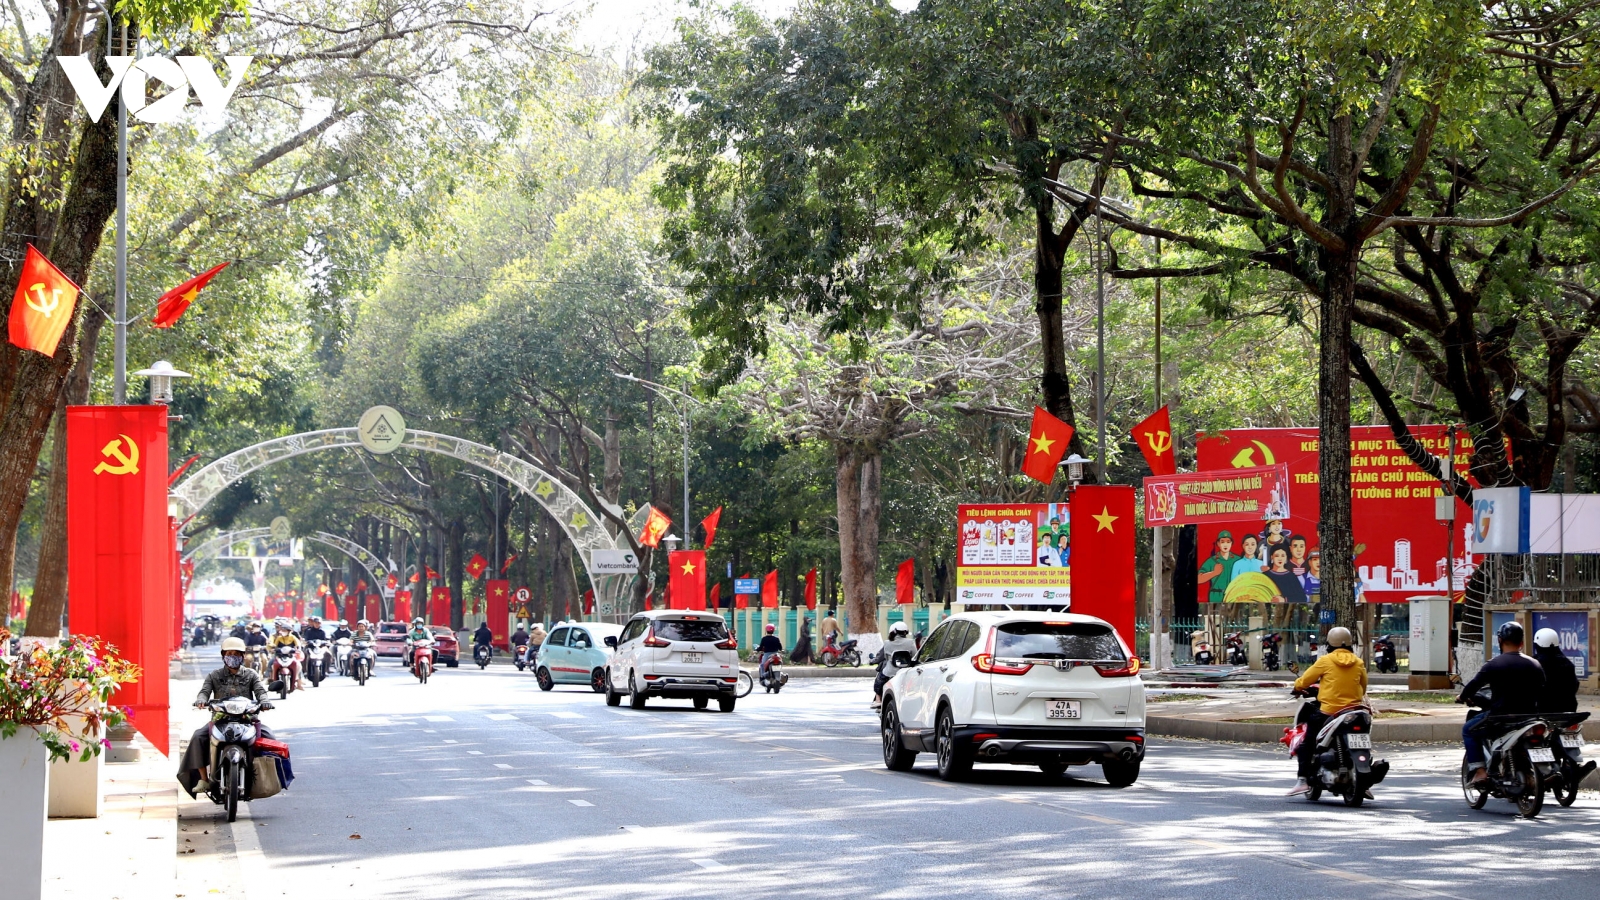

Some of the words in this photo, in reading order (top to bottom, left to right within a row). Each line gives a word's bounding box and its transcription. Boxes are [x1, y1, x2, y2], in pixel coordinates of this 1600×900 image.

[1301, 439, 1319, 452] KIÊ
[1358, 440, 1383, 452] MỤC
[1386, 439, 1402, 450] TI
[1371, 454, 1388, 466] VỚI
[1350, 469, 1378, 482] TẢNG
[1382, 469, 1403, 482] CHỦ
[1406, 472, 1440, 482] NGH
[1356, 486, 1391, 499] TƯỞNG
[1413, 486, 1431, 498] CHÍ
[966, 508, 979, 516] TIÊU
[981, 508, 996, 518] LỆNH
[997, 508, 1014, 516] CHỮA
[1015, 508, 1032, 516] CHÁY
[1056, 701, 1070, 709] 47A
[1050, 709, 1077, 718] 395.93
